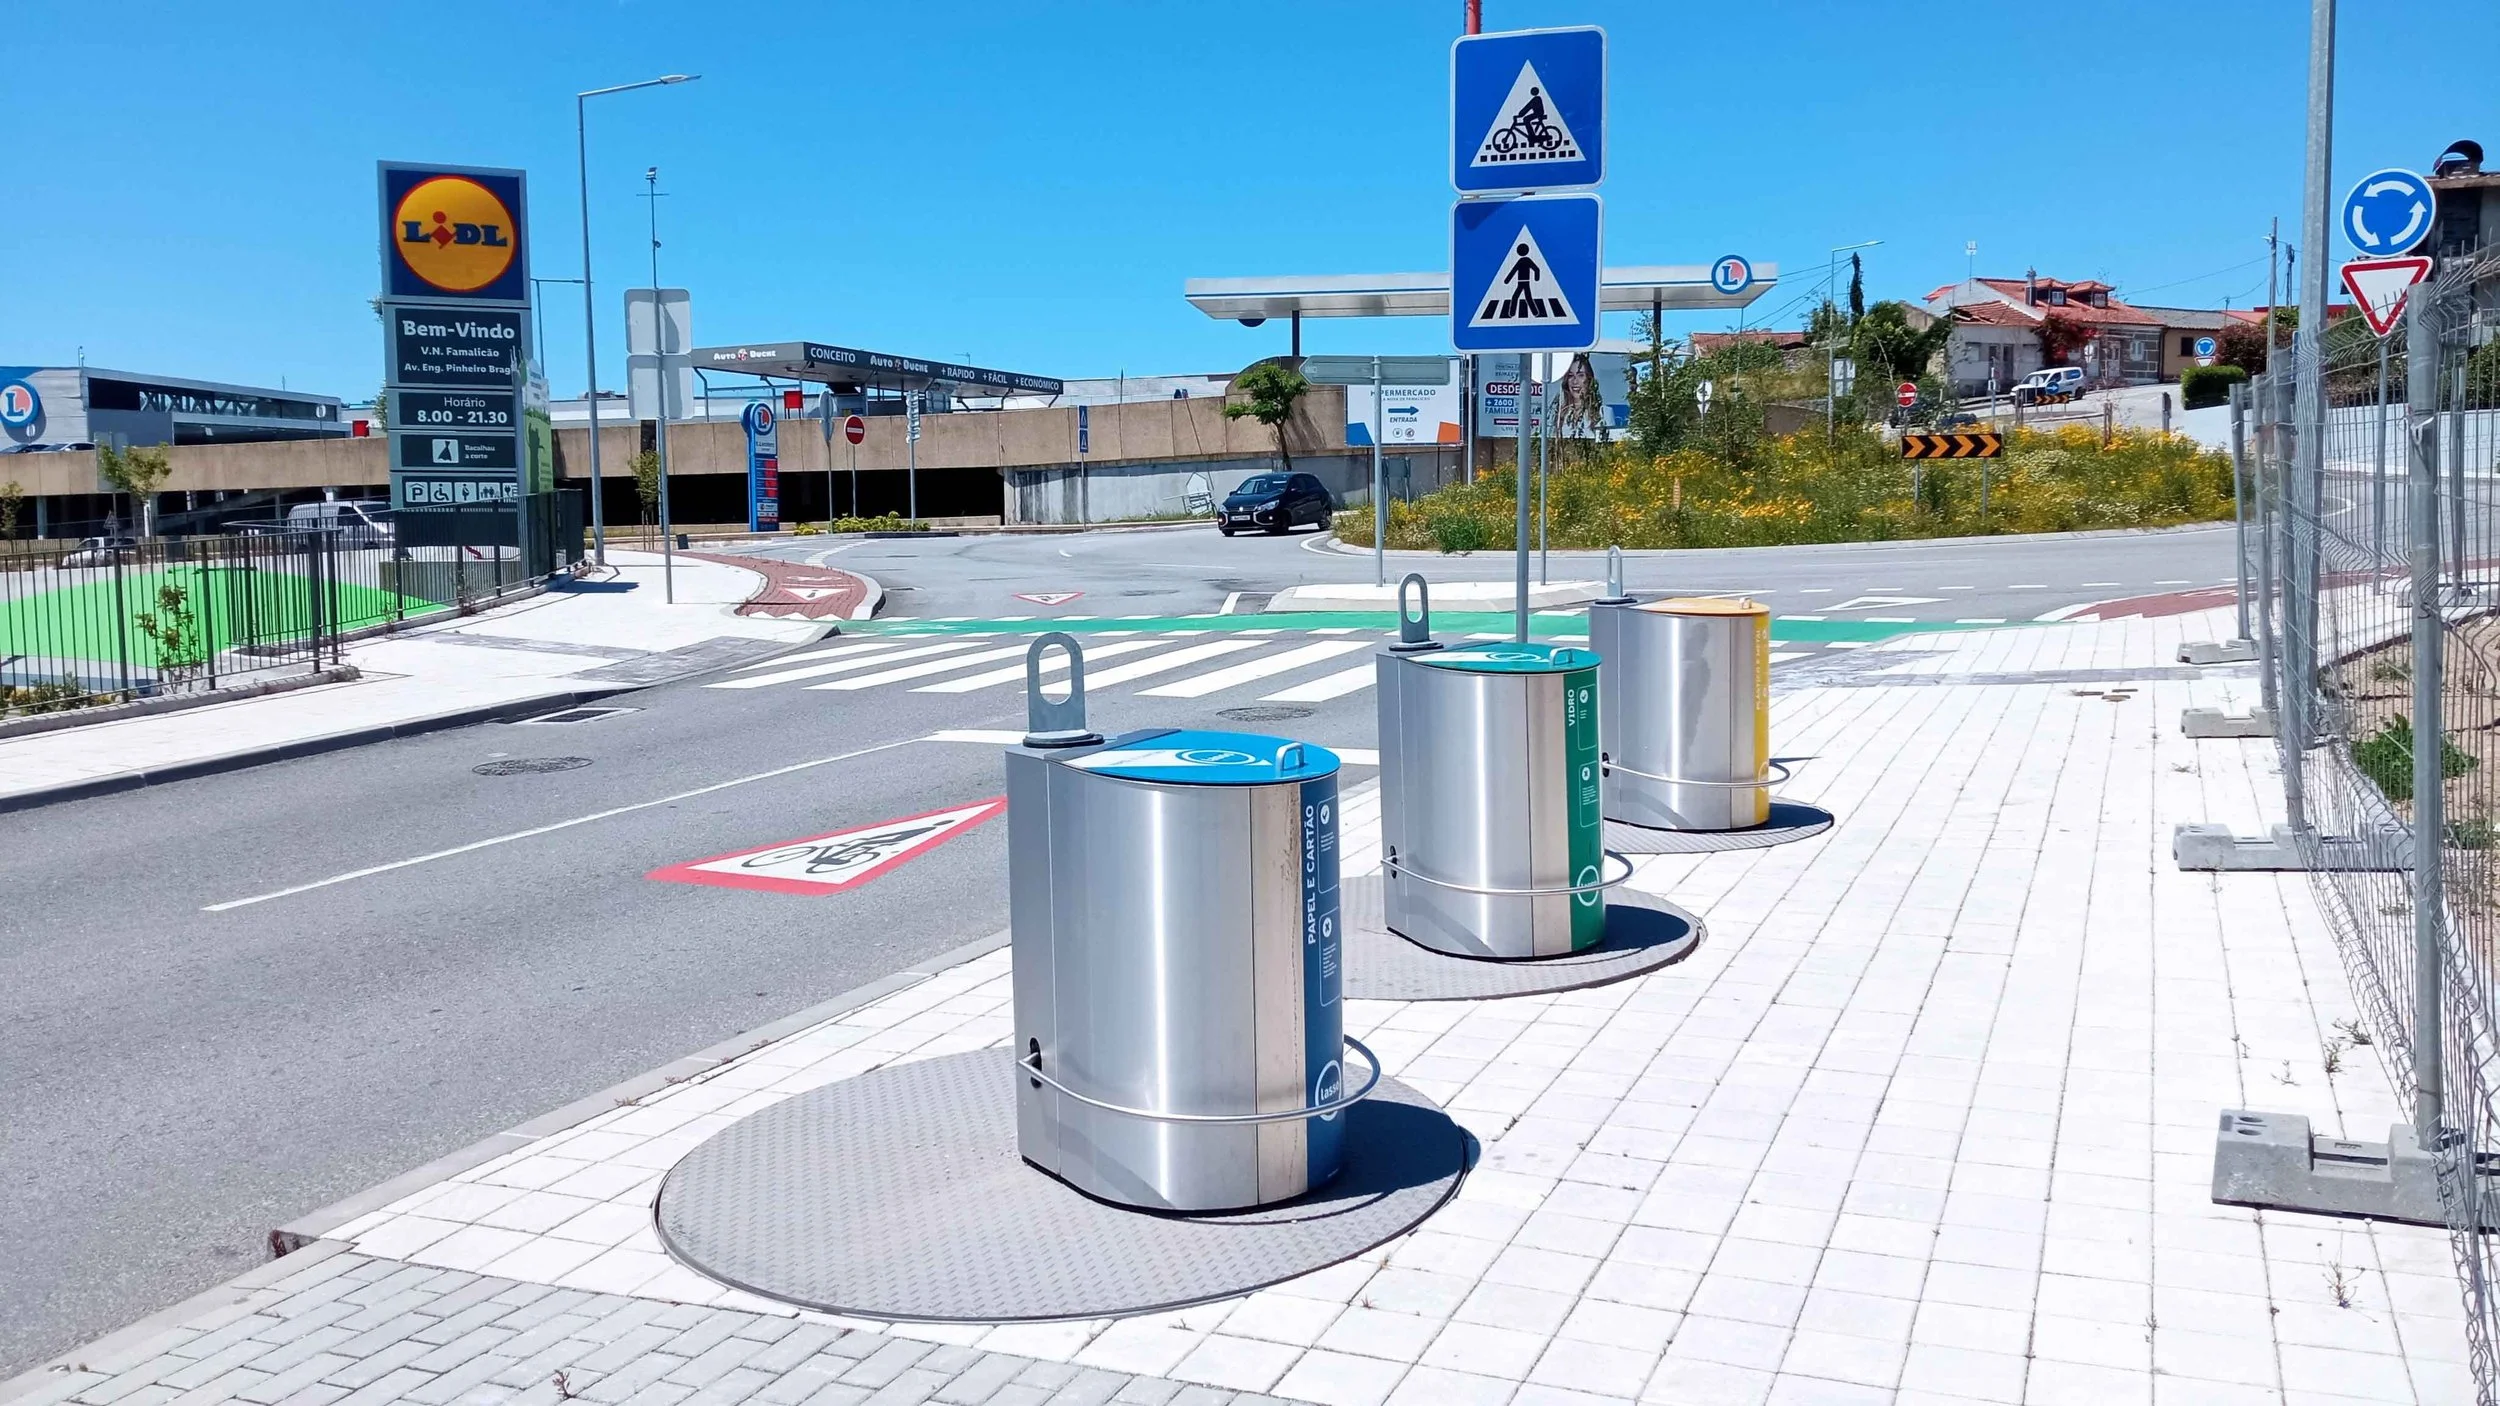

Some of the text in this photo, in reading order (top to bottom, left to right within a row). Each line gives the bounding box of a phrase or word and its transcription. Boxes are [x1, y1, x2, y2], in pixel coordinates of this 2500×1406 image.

[402, 320, 515, 339] Bem-Vindo
[420, 346, 500, 358] V.N. Famalicão
[810, 347, 856, 363] CONCEITO
[404, 363, 511, 376] Av. Eng. Pinheiro Brag
[1370, 389, 1437, 397] HPERMERCADO
[1490, 384, 1520, 394] DESDE
[444, 396, 486, 408] Horário
[417, 409, 453, 423] 8.00
[467, 411, 508, 424] 21.30
[1567, 688, 1576, 727] VIDRO
[1304, 805, 1317, 945] PAPEL E CARTÃO
